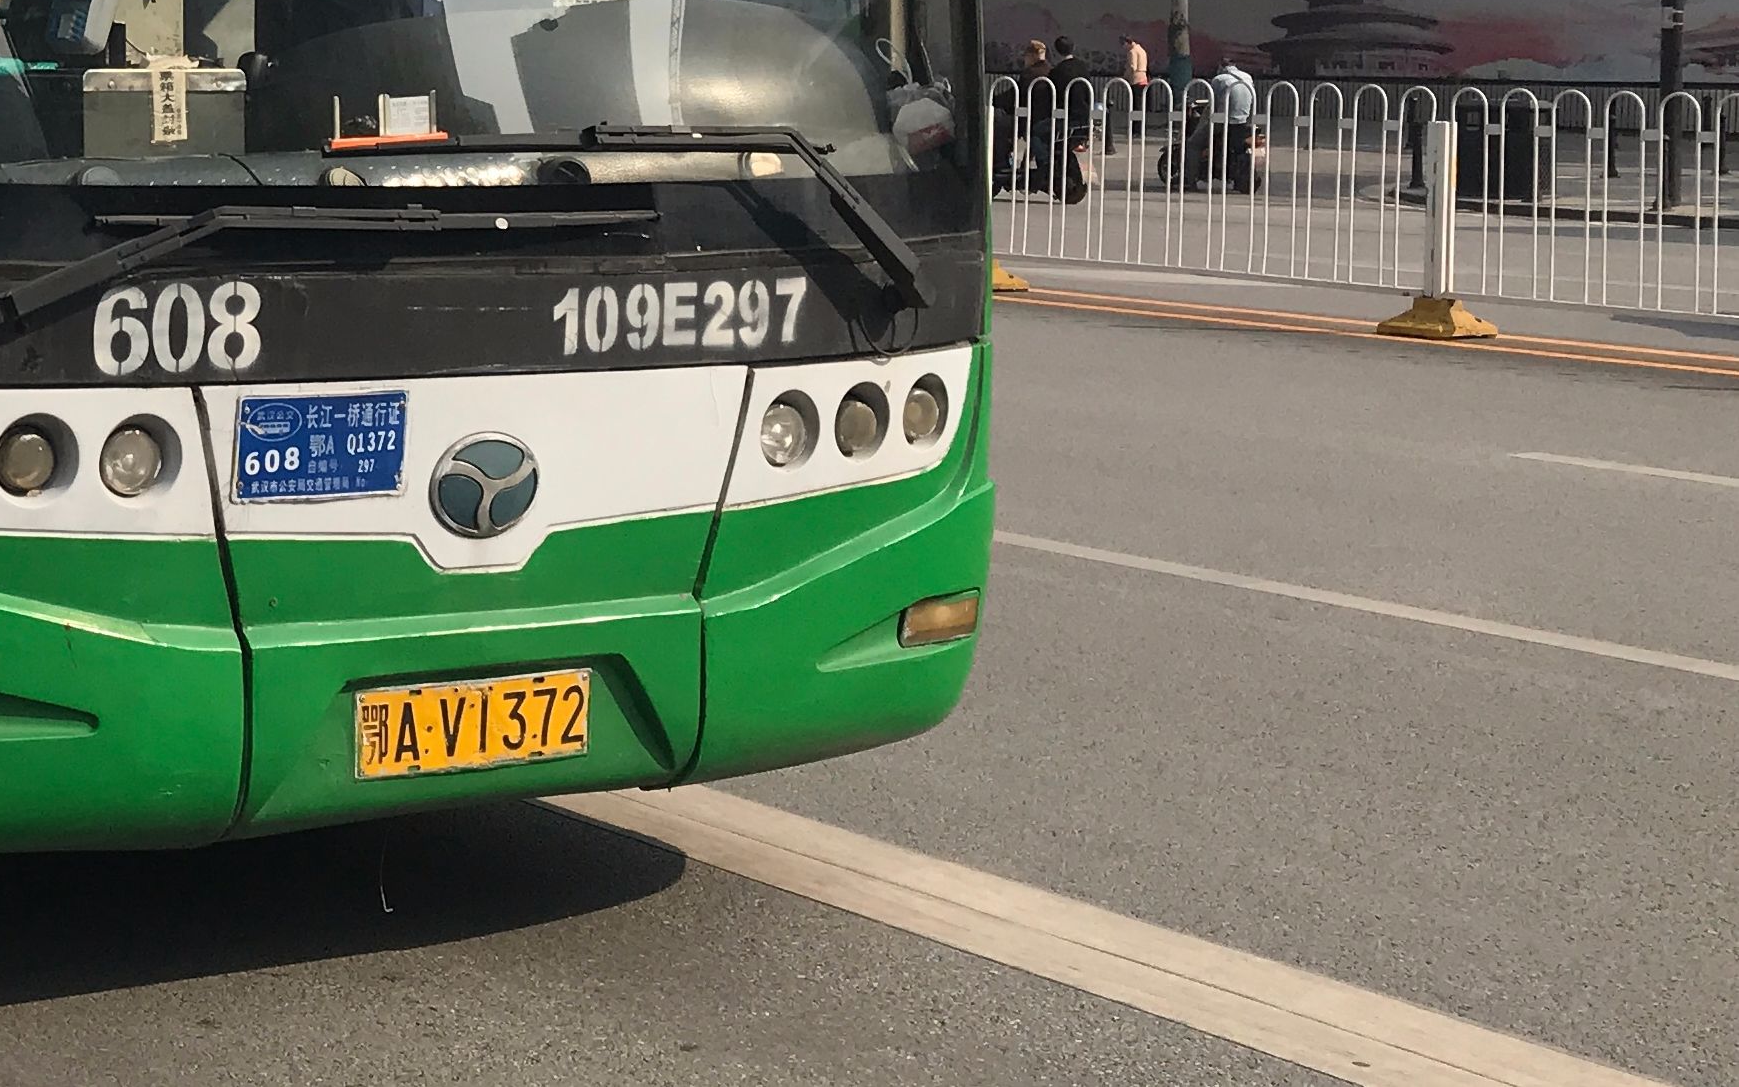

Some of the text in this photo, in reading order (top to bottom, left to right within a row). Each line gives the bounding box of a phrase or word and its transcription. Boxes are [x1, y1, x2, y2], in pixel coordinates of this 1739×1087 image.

[94, 281, 261, 376] 608
[553, 277, 807, 355] 109E297
[306, 402, 400, 429] 长江一桥通行证
[347, 430, 396, 455] Q1372
[245, 446, 300, 475] 608
[358, 459, 375, 473] 297
